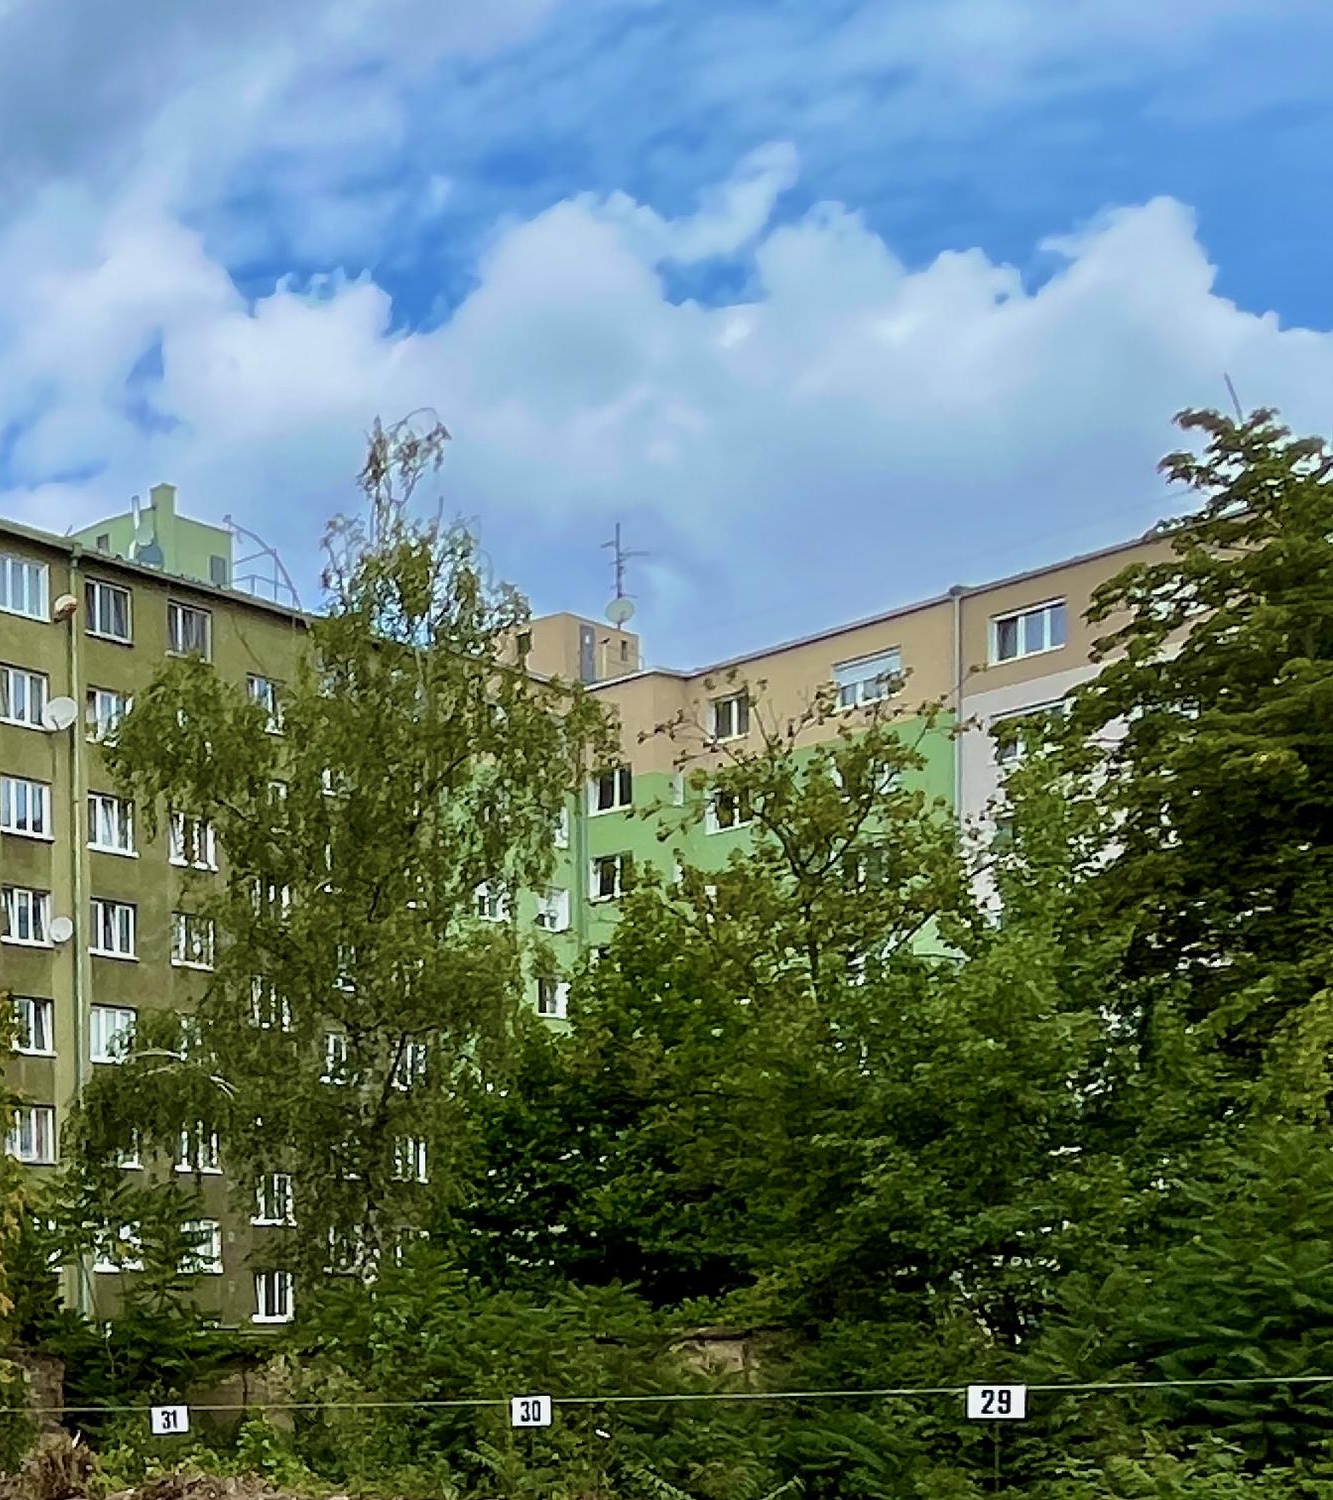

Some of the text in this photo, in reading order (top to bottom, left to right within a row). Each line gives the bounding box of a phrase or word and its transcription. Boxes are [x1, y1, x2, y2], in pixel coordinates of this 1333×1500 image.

[521, 1400, 541, 1422] 30
[981, 1389, 1011, 1415] 29
[161, 1410, 177, 1429] 31
